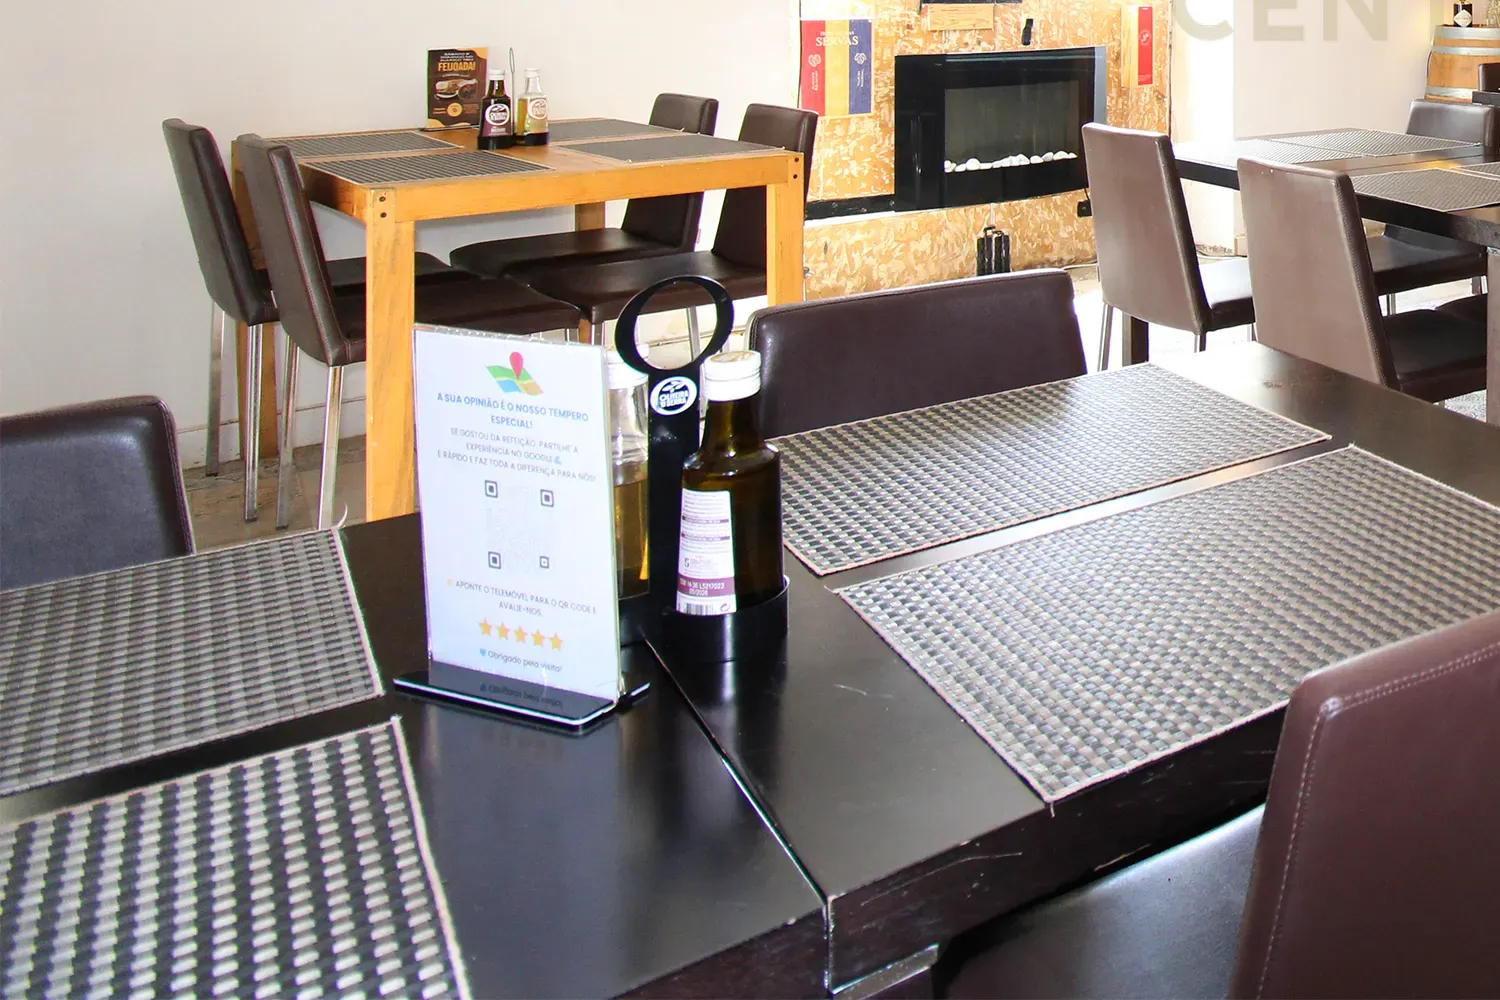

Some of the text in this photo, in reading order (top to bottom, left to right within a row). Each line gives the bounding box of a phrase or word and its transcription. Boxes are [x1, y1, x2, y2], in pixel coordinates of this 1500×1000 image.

[815, 35, 859, 47] SERVAS
[437, 393, 443, 402] A
[445, 393, 463, 404] SUA
[464, 395, 499, 409] OPINIÃO
[507, 402, 514, 411] O
[516, 404, 546, 416] NOSSO
[548, 407, 589, 422] TEMPERO
[491, 415, 533, 429] ESPECIAL!
[450, 427, 458, 436] SE
[459, 429, 489, 441] GOSTOU
[490, 433, 500, 442] DA
[511, 449, 522, 458] NO
[524, 451, 552, 463] GOOGLE
[475, 456, 488, 466] FAZ
[490, 458, 509, 469] TODA
[557, 469, 577, 479] PARA
[456, 580, 482, 592] APONTE
[530, 595, 549, 605] PARA
[558, 600, 569, 609] QR
[570, 602, 591, 613] CODE
[488, 650, 522, 666] Obrigado
[523, 656, 539, 668] pela
